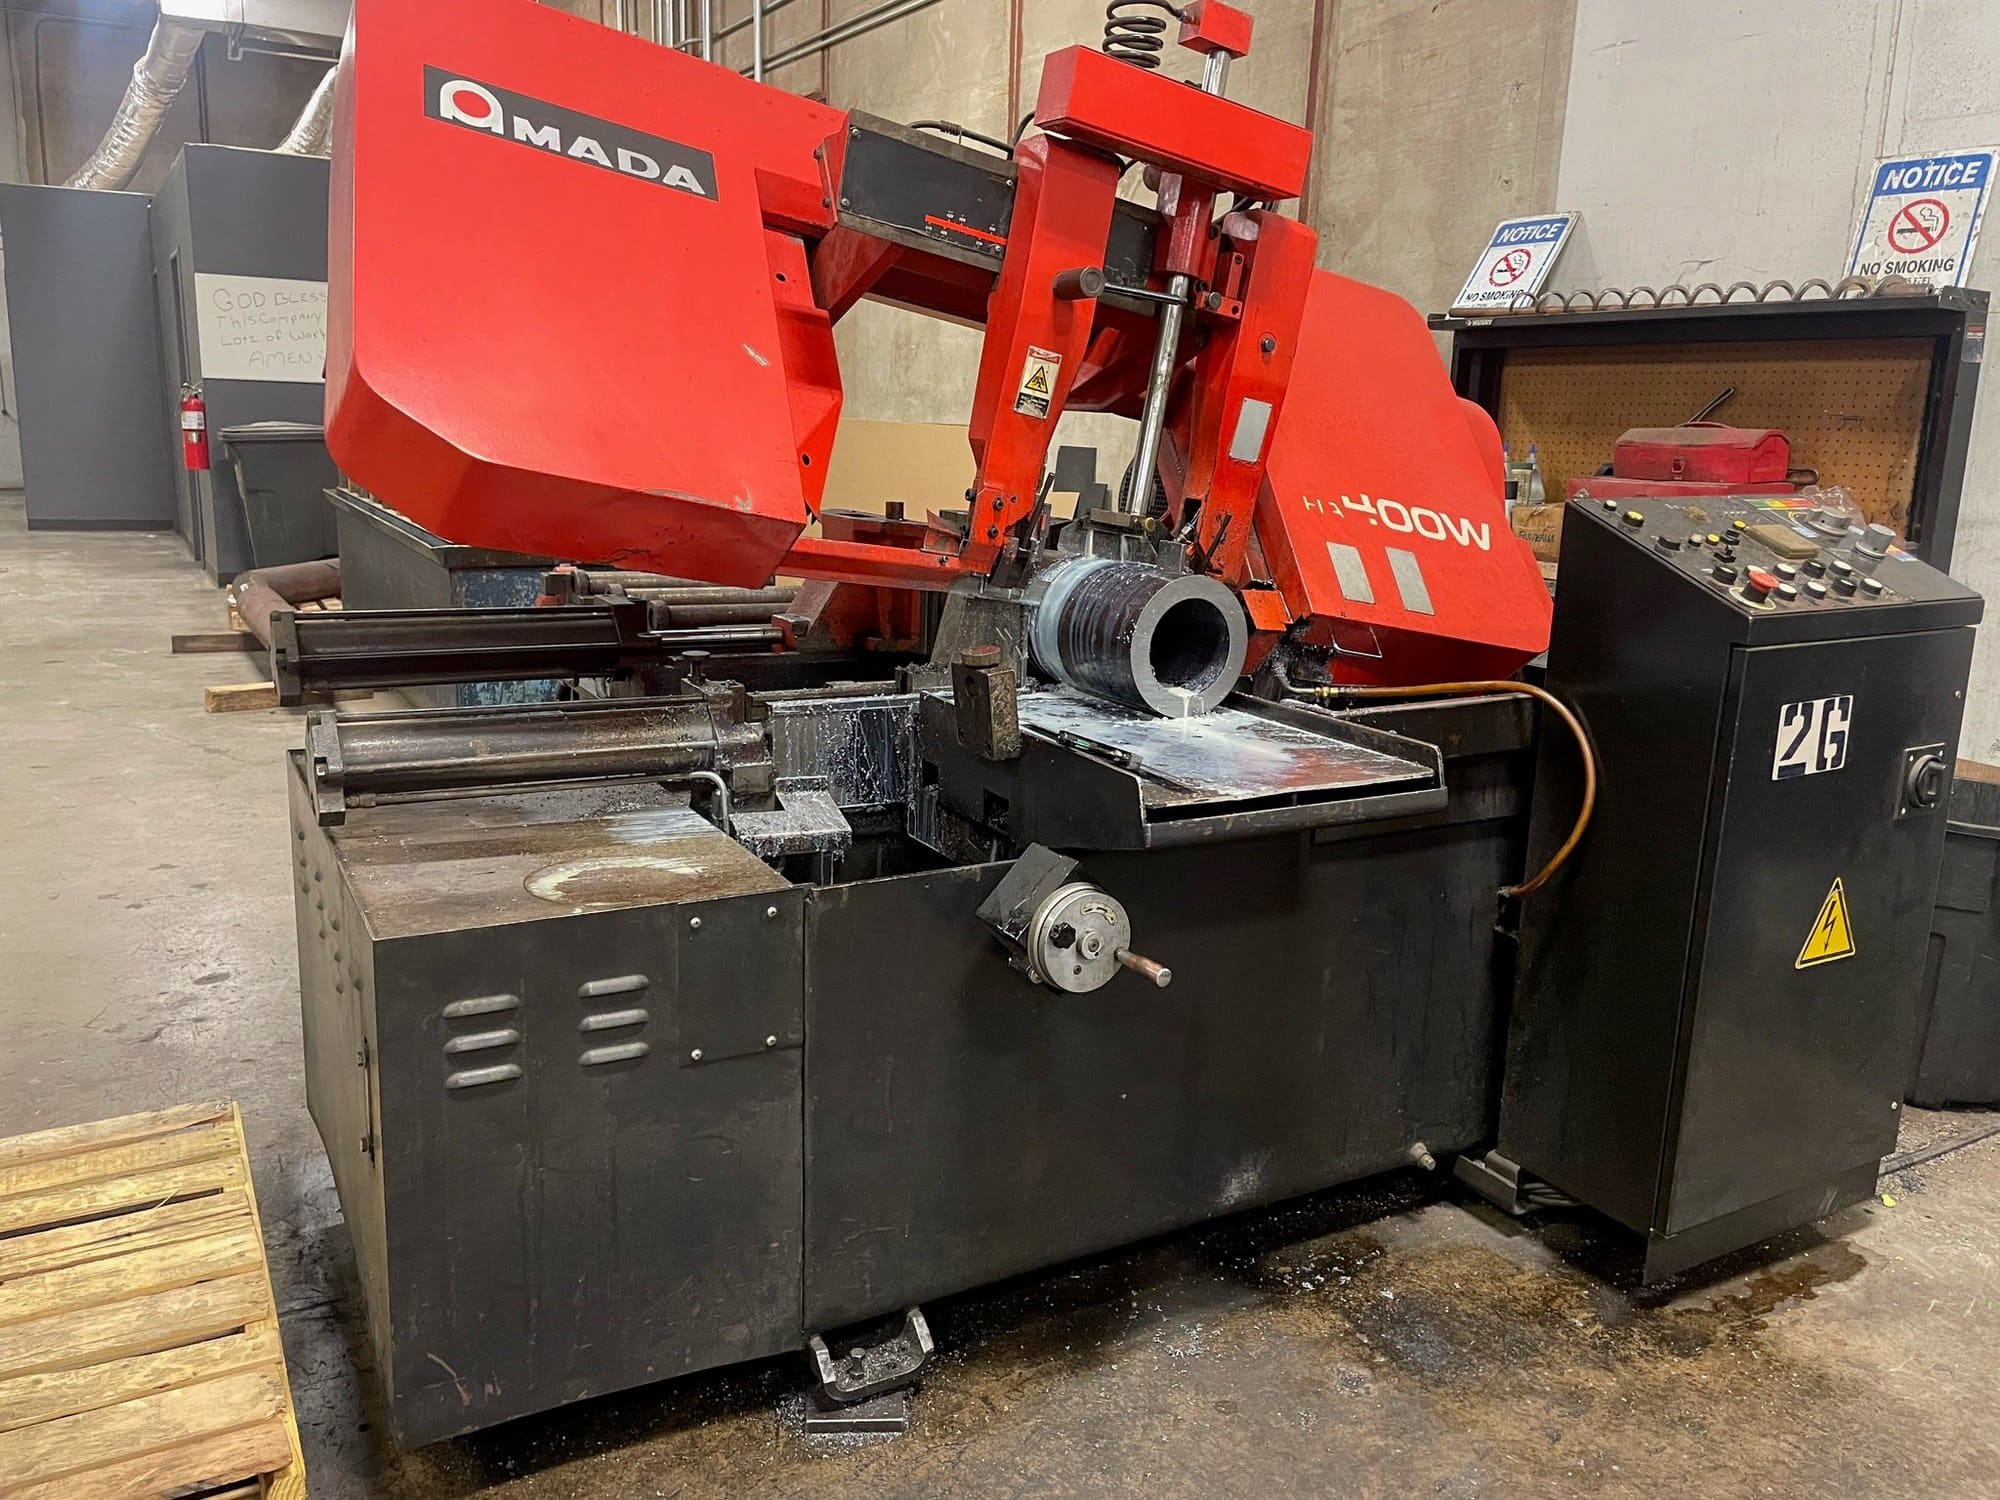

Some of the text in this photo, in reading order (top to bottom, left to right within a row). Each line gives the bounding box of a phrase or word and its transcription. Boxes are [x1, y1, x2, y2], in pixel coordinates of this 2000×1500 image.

[440, 80, 705, 194] AMADA
[1882, 161, 1983, 190] NOTICE
[1497, 223, 1562, 243] NOTICE
[1860, 258, 1955, 276] NO SMOKING
[213, 288, 328, 312] GOD BLESS
[1465, 293, 1480, 302] NO
[248, 351, 312, 367] AMEN
